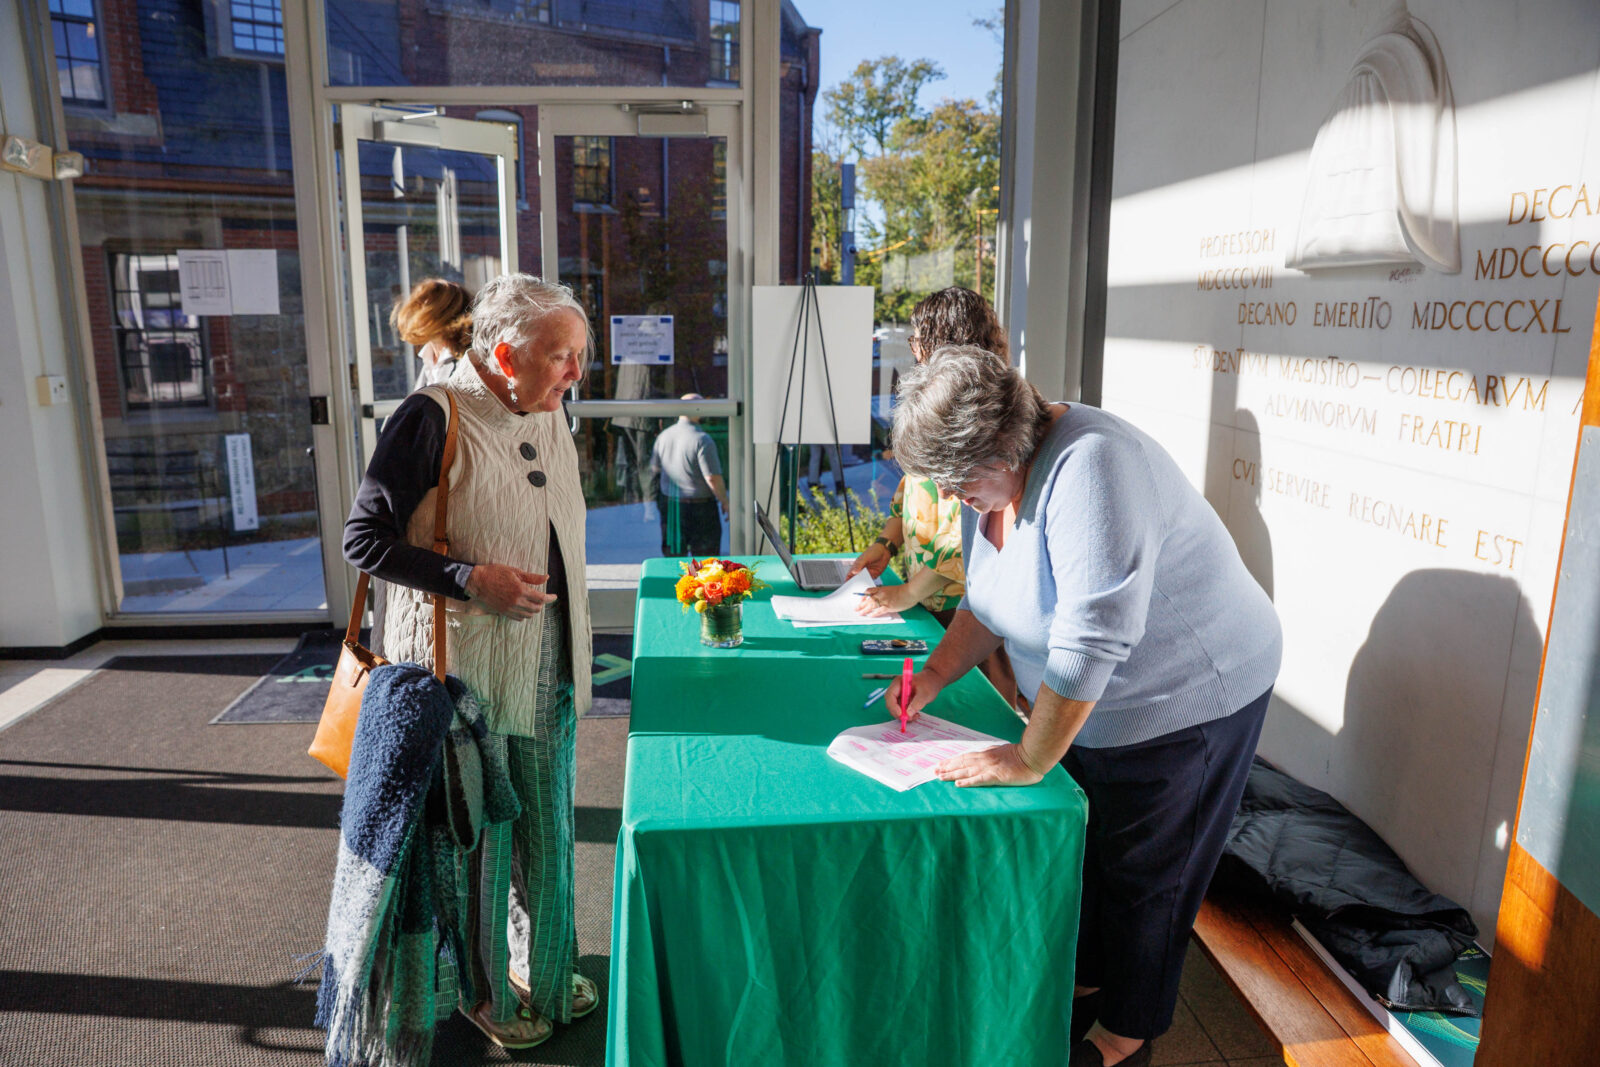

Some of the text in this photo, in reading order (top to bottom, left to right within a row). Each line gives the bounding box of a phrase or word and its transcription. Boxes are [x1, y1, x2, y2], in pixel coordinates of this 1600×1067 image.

[1507, 182, 1600, 226] DECA
[1199, 227, 1276, 258] PROFESSORI
[1197, 264, 1273, 291] MDCCCCVIII
[1238, 296, 1572, 333] DECANO EMERITO MDCCCCXL
[1279, 355, 1360, 389] MAGISTRO
[1386, 365, 1550, 412] COLLEGARVM
[1264, 393, 1482, 456] ALVMNORVM FRATRI
[1232, 457, 1524, 571] CVI SERVIRE REGNARE EST
